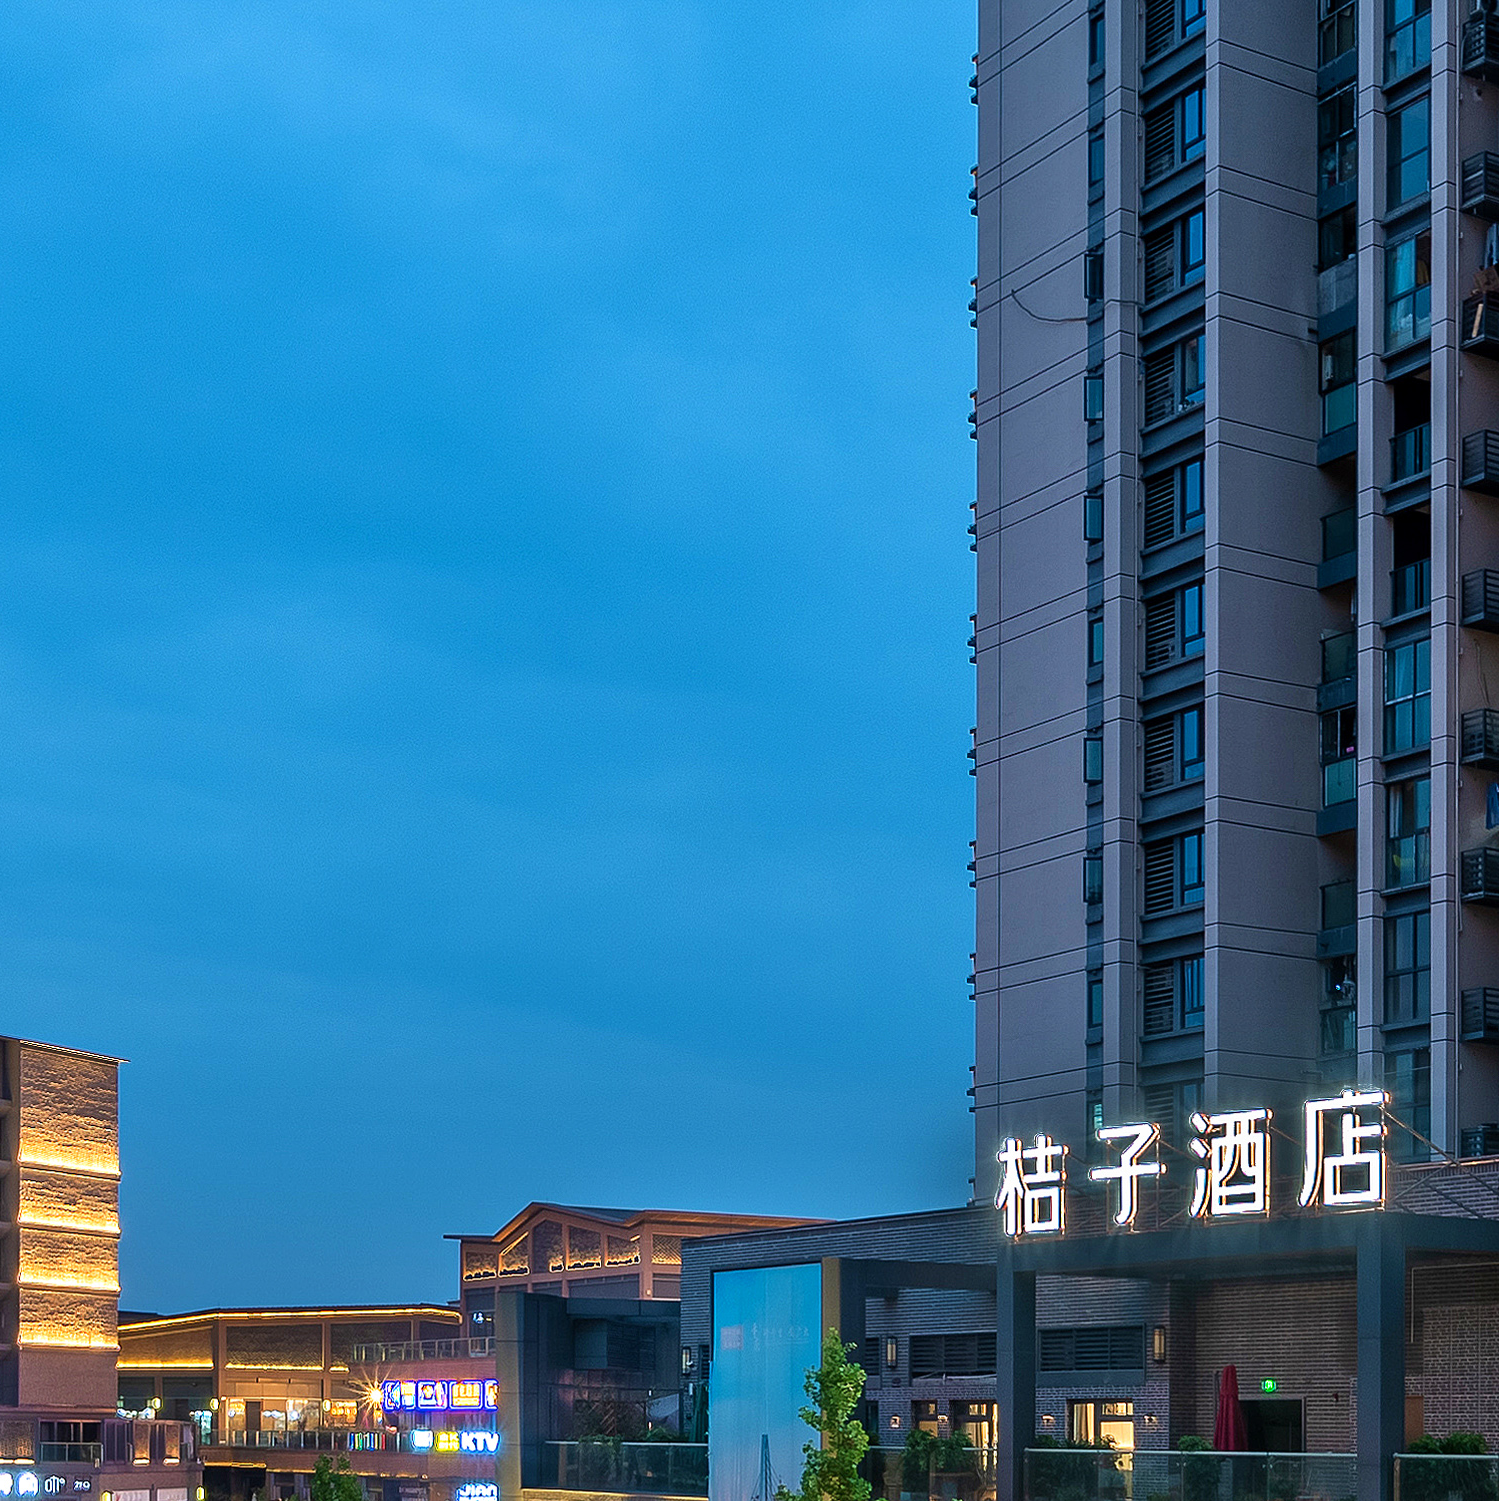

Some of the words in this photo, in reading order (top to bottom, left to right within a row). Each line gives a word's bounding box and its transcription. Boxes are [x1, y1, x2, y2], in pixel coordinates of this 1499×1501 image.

[996, 1088, 1390, 1239] 桔子酒店
[460, 1432, 499, 1453] KTV
